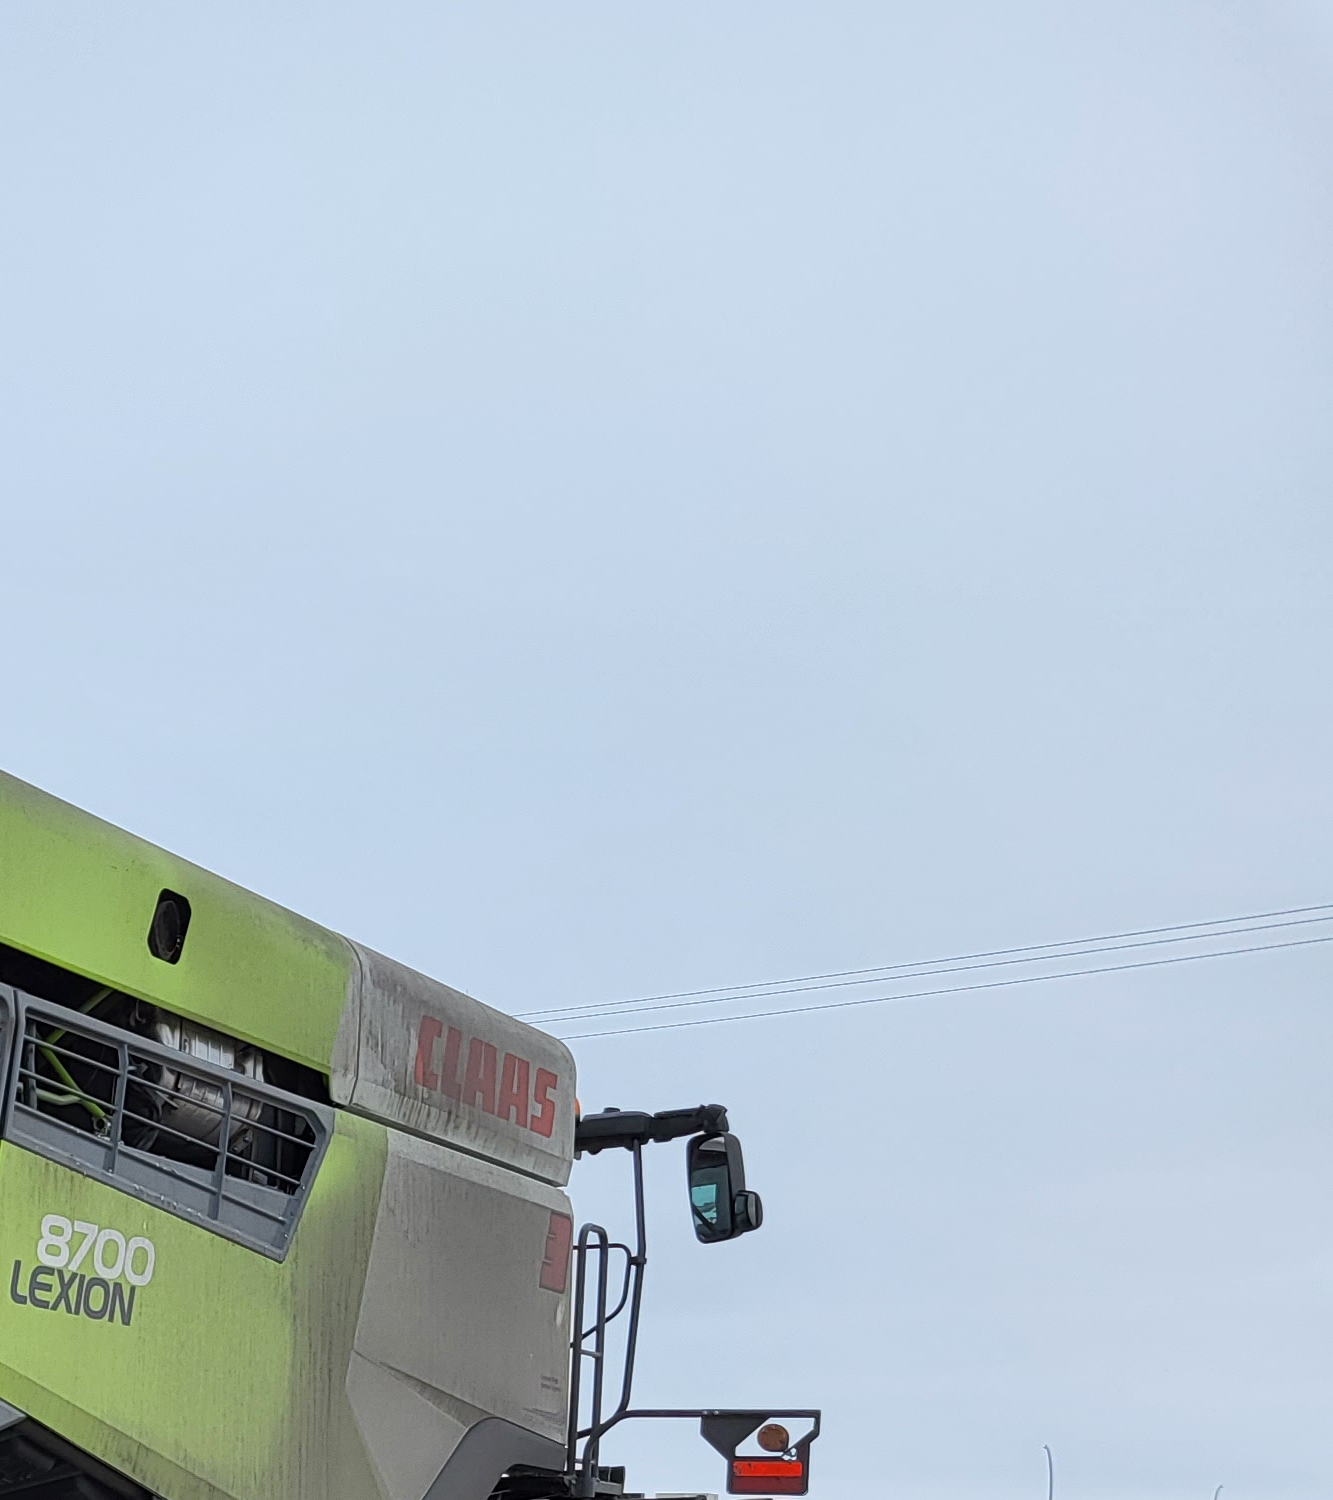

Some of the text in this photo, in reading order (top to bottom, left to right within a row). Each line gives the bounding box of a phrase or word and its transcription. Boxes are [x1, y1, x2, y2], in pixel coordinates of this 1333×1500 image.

[413, 1014, 558, 1139] CLAAS
[36, 1213, 156, 1287] 8700
[9, 1258, 137, 1327] LEXION
